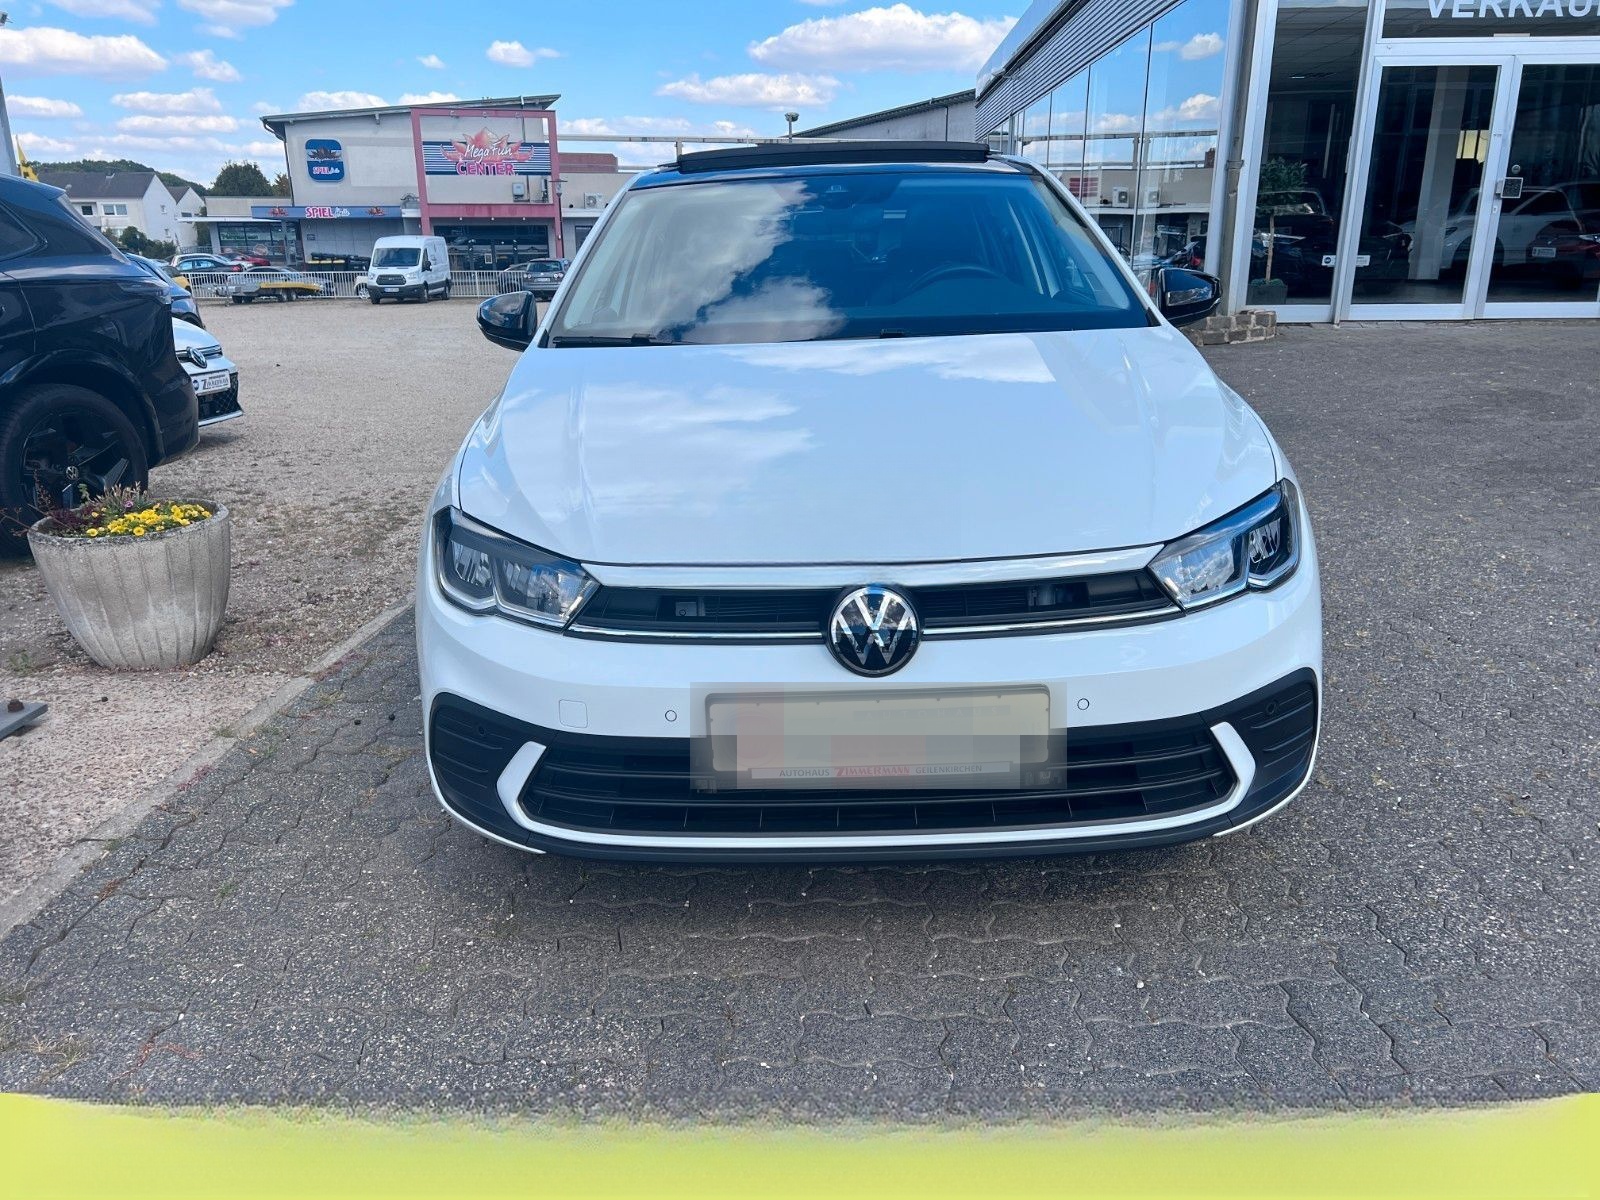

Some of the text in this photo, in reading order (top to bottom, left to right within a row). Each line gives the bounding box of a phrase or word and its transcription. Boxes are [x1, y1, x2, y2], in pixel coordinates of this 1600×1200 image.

[1428, 0, 1600, 18] VERKAU
[465, 141, 513, 163] Mega Fun
[312, 166, 330, 175] SPIEL
[456, 162, 514, 176] CENTER
[305, 206, 334, 219] SPIEL
[779, 764, 983, 777] AUTOHAUS ZIMMERMANN GEILENKIRCHEN
